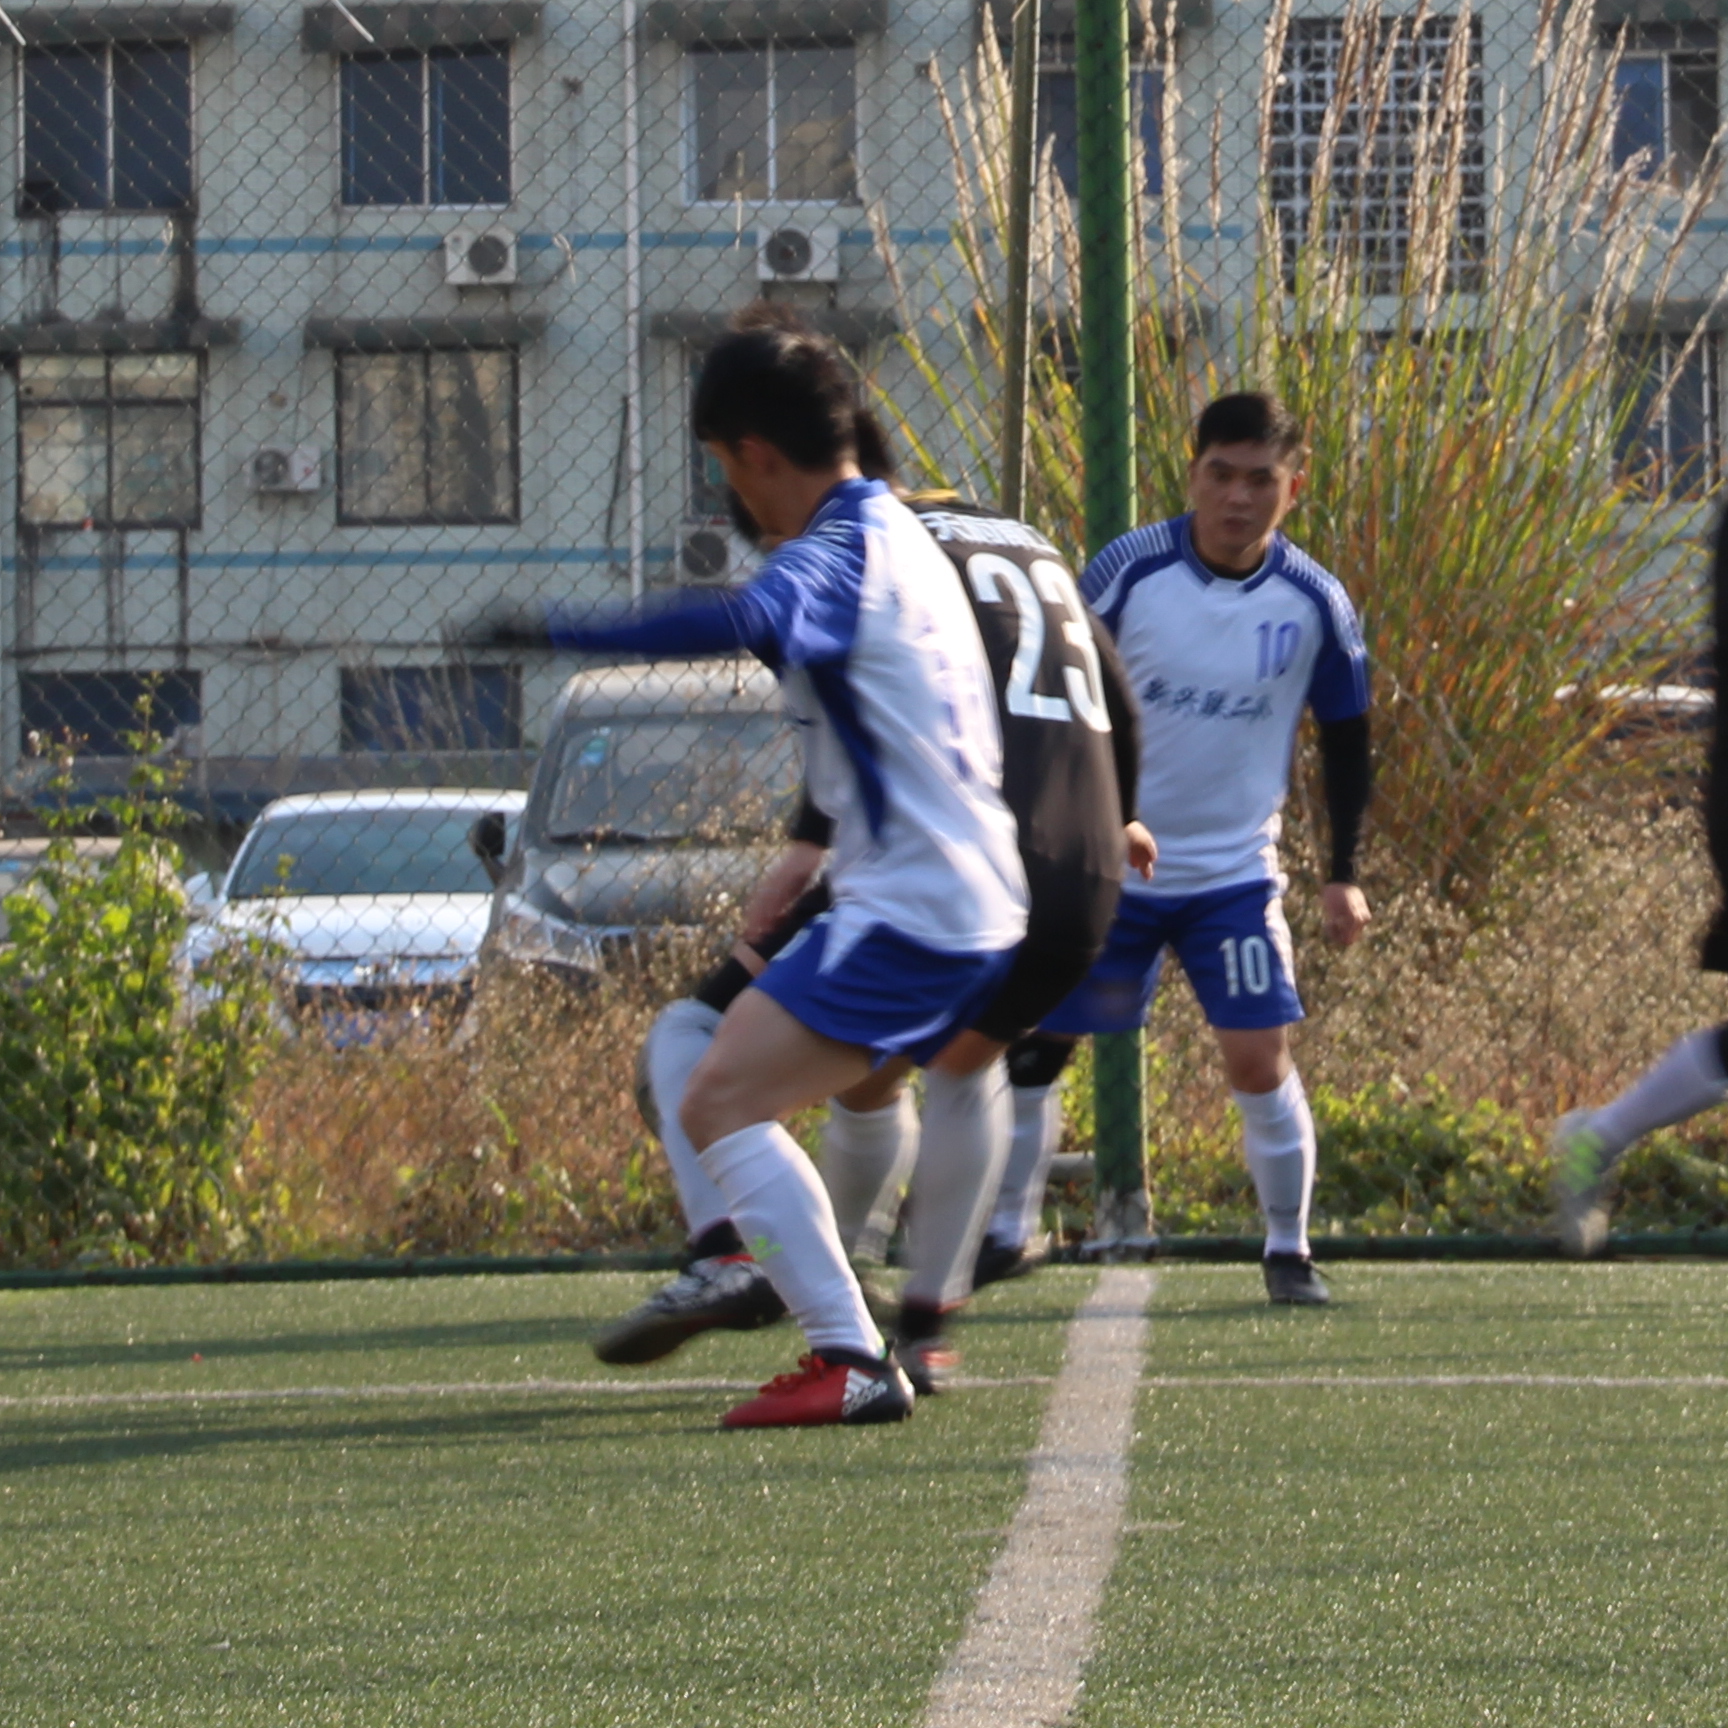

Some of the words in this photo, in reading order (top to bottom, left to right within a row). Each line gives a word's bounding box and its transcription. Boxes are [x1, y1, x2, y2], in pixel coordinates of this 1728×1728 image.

[966, 553, 1112, 733] 23
[1254, 620, 1301, 682] 10
[1218, 935, 1271, 997] 10
